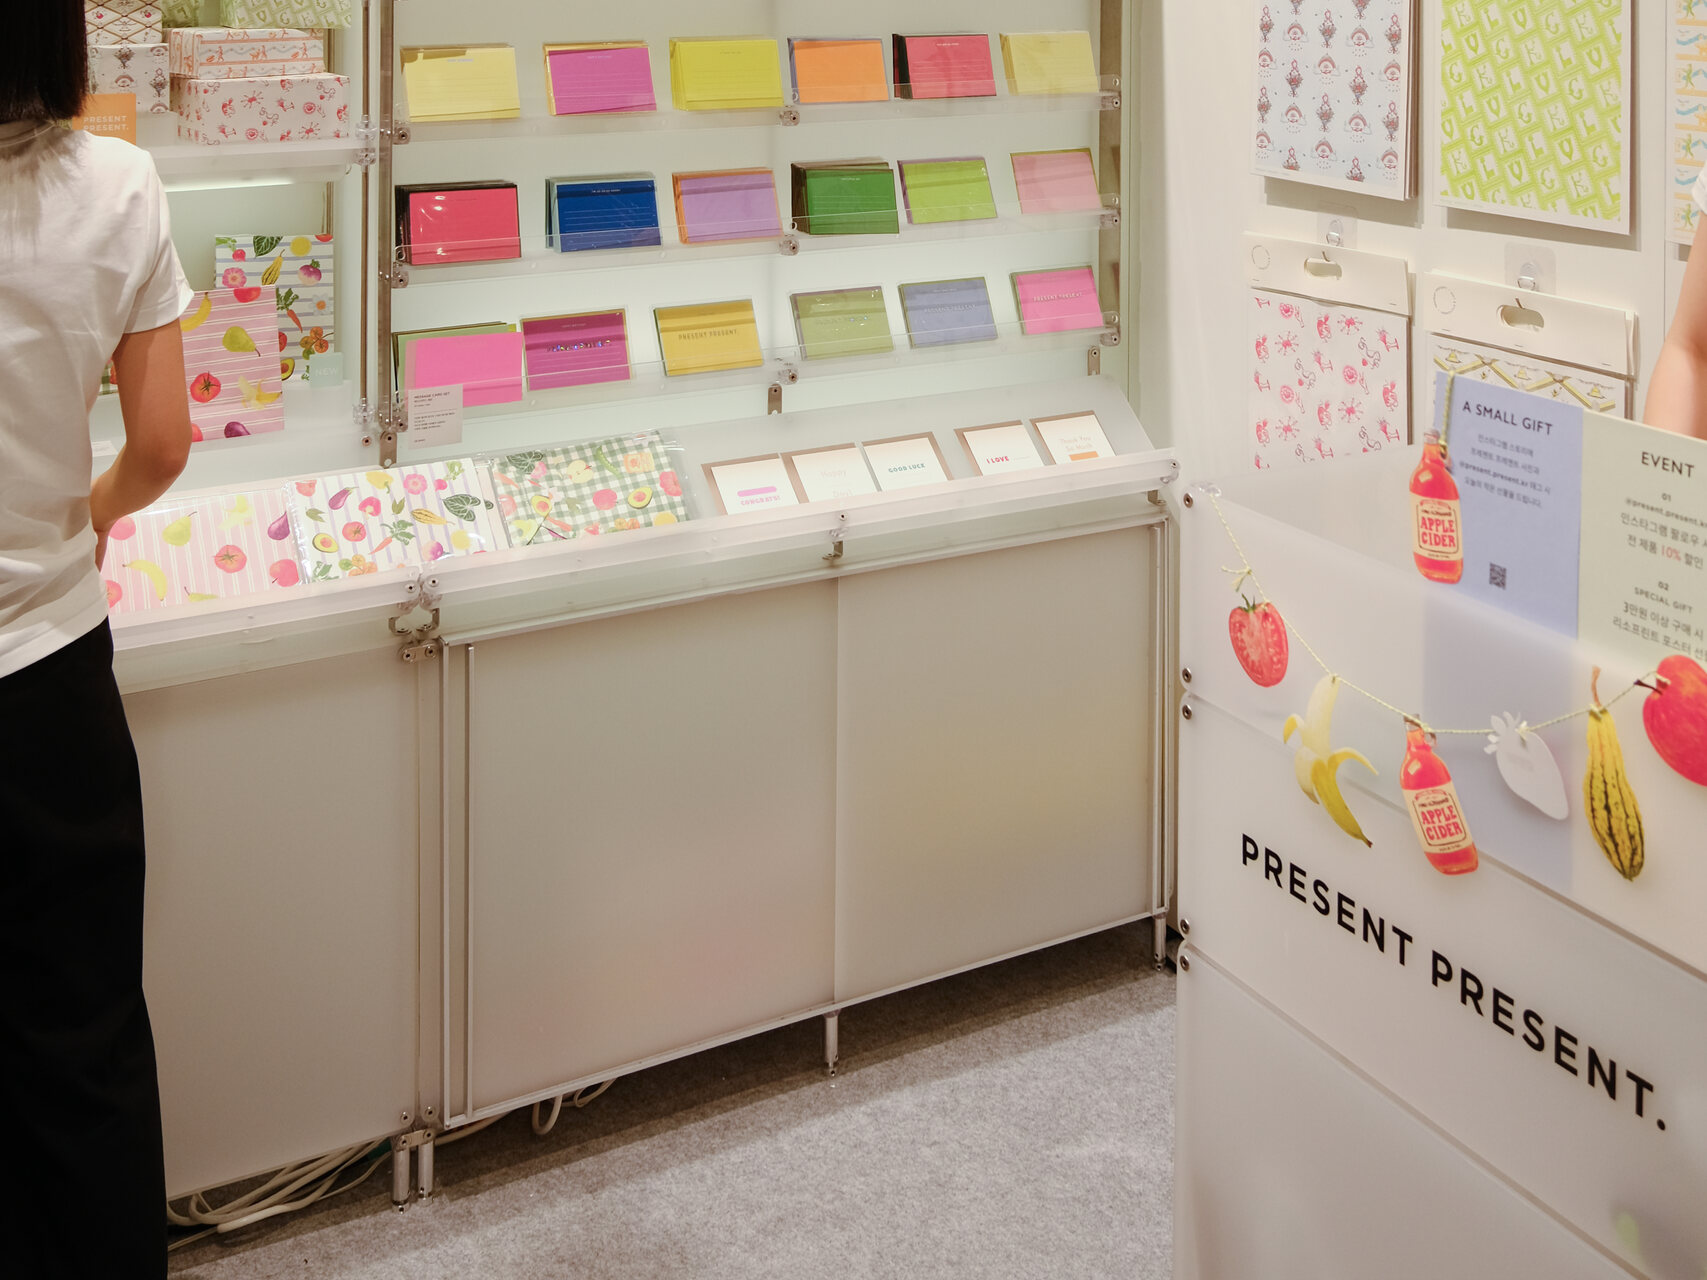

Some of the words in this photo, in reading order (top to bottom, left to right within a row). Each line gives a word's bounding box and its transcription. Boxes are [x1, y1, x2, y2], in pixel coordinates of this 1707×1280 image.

[83, 115, 128, 123] PRESENT
[1462, 401, 1472, 413] A
[1475, 404, 1518, 426] SMALL
[1522, 417, 1553, 436] GIFT
[887, 464, 908, 473] GOOD
[908, 463, 926, 471] LUCK
[991, 455, 1010, 464] LOVE
[1640, 451, 1695, 478] EVENT
[1661, 492, 1672, 503] 01
[1420, 516, 1456, 534] APPLE
[1620, 512, 1668, 538] 인스타그램
[1671, 527, 1699, 547] 팔로우
[1421, 531, 1456, 548] CIDER
[1627, 534, 1637, 548] 전
[1639, 538, 1657, 555] 제품
[1661, 544, 1682, 562] 10%
[1684, 552, 1704, 570] 할인
[1657, 580, 1669, 592] 02
[1634, 586, 1671, 607] SPECIAL
[1672, 600, 1694, 614] GIFT
[1623, 601, 1648, 622] 3만원
[1649, 611, 1670, 629] 이상
[1672, 619, 1692, 637] 구매
[1694, 627, 1704, 641] 시
[1612, 616, 1661, 644] 리소프린트
[1662, 634, 1692, 656] 포스터
[1420, 804, 1457, 825] APPLE
[1425, 821, 1463, 841] CIDER
[1242, 832, 1413, 967] PRESENT
[1431, 950, 1668, 1131] PRESENT.
